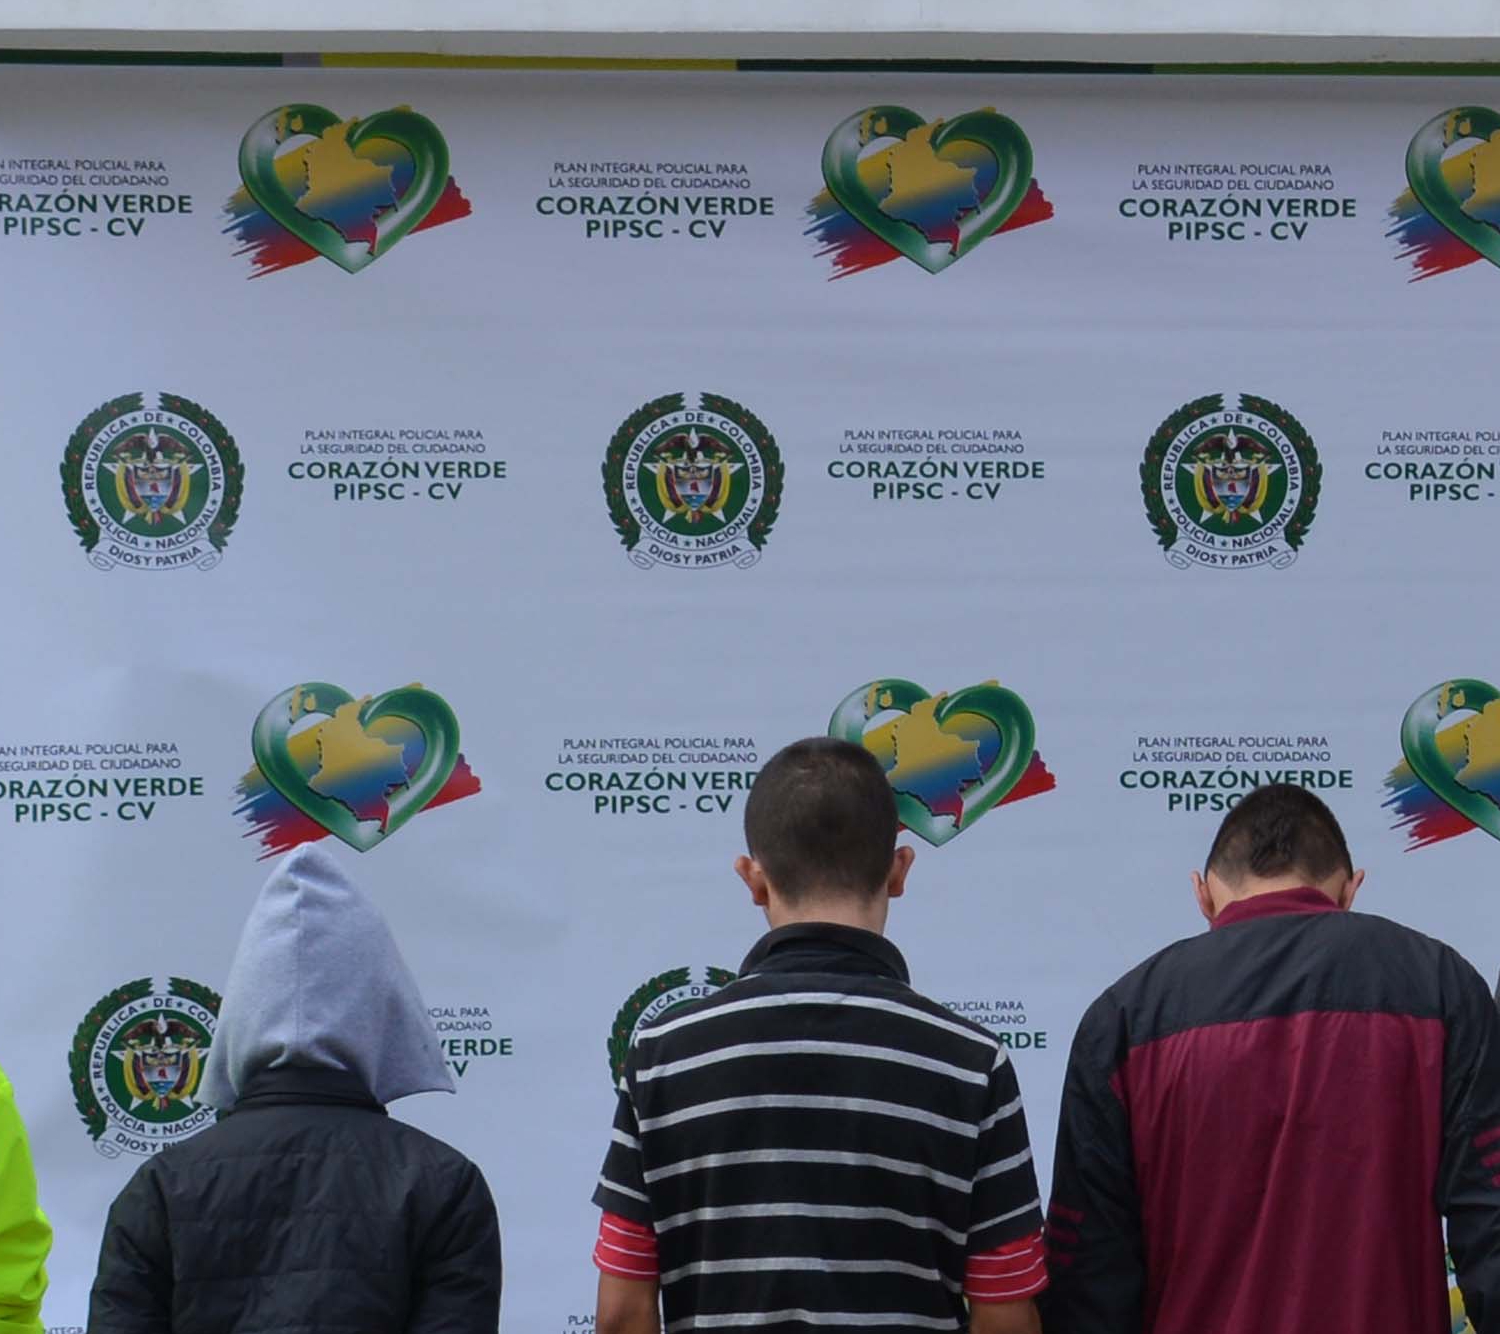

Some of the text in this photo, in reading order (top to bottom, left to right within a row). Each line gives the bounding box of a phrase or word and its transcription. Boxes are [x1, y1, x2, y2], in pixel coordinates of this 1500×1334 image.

[8, 158, 71, 171] INTEGRAL
[74, 159, 131, 172] POLICIAL
[134, 160, 166, 172] PARA
[62, 174, 86, 186] DEL
[89, 174, 169, 187] CIUDADANO
[102, 194, 194, 214] VERDE
[535, 190, 775, 216] CORAZÓN VERDE
[1118, 193, 1357, 218] CORAZÓN VERDE
[3, 216, 82, 237] PIPSC
[106, 216, 146, 237] CV
[585, 219, 664, 239] PIPSC
[687, 219, 727, 239] CV
[1168, 221, 1246, 241] PIPSC
[1269, 221, 1309, 241] CV
[84, 412, 222, 492] REPUBLICA DE COLOMBIA
[287, 455, 507, 480] CORAZÓN VERDE
[827, 455, 1045, 480] CORAZÓN VERDE
[1364, 457, 1495, 481] CORAZÓN
[333, 482, 405, 501] PIPSC
[427, 481, 463, 501] CV
[872, 481, 944, 500] PIPSC
[965, 481, 1002, 500] CV
[1409, 483, 1480, 502] PIPSC
[93, 505, 217, 549] POLICIA NACIONAL
[108, 544, 142, 565] DIOS
[154, 546, 202, 567] PATRIA
[112, 776, 205, 798] VERDE
[544, 766, 757, 792] CORAZÓN VER
[1119, 764, 1353, 790] CORAZÓN VERDE
[14, 801, 92, 824] PIPSC
[116, 800, 157, 822] CV
[594, 794, 671, 815] PIPSC
[695, 794, 733, 814] CV
